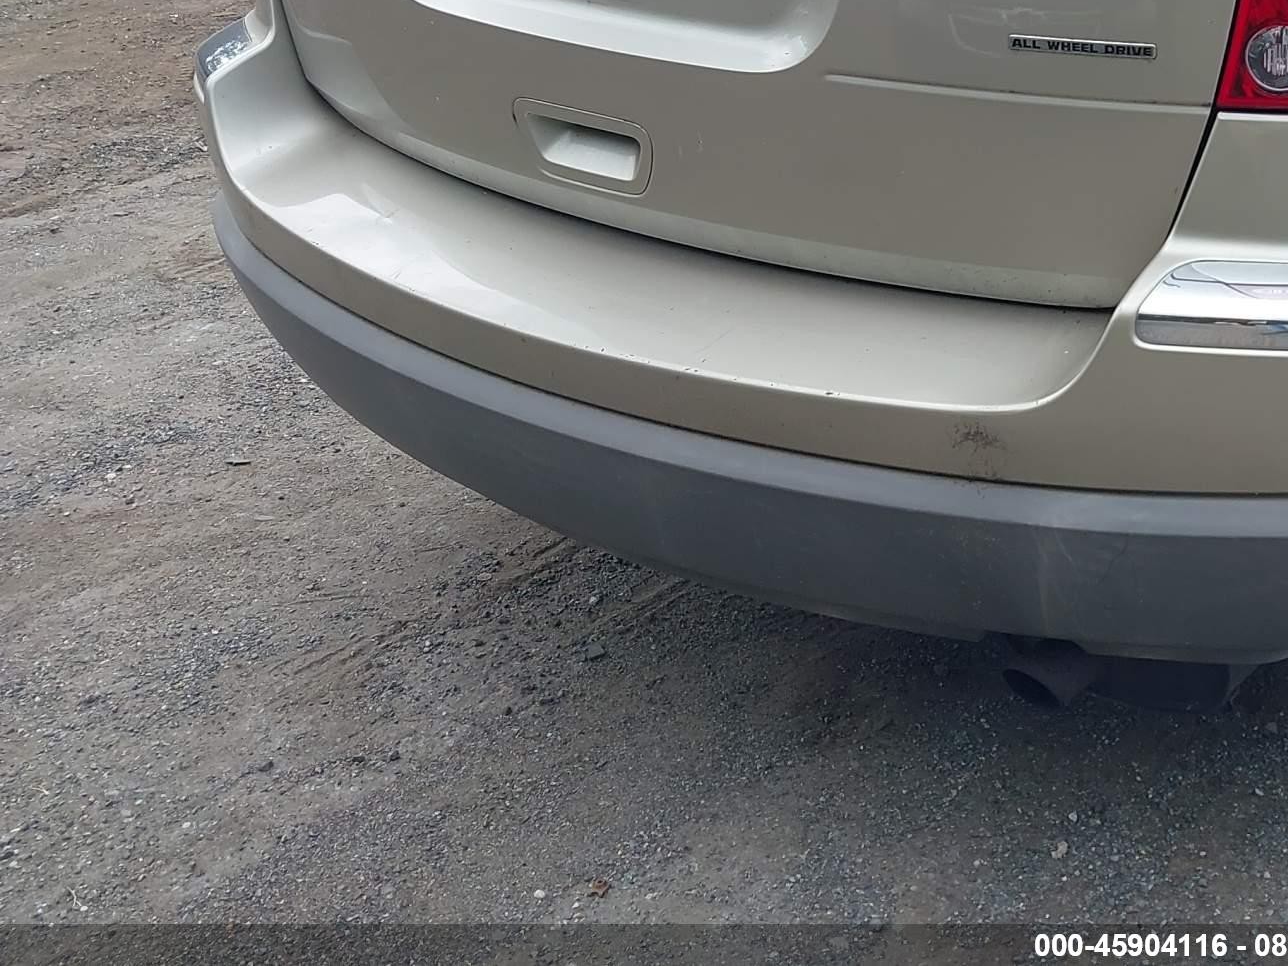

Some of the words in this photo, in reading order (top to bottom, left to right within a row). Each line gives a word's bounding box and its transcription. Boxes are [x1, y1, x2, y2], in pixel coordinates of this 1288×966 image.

[1011, 38, 1041, 50] ALL
[1047, 41, 1098, 53] WHEEL
[1104, 45, 1153, 57] DRIVE
